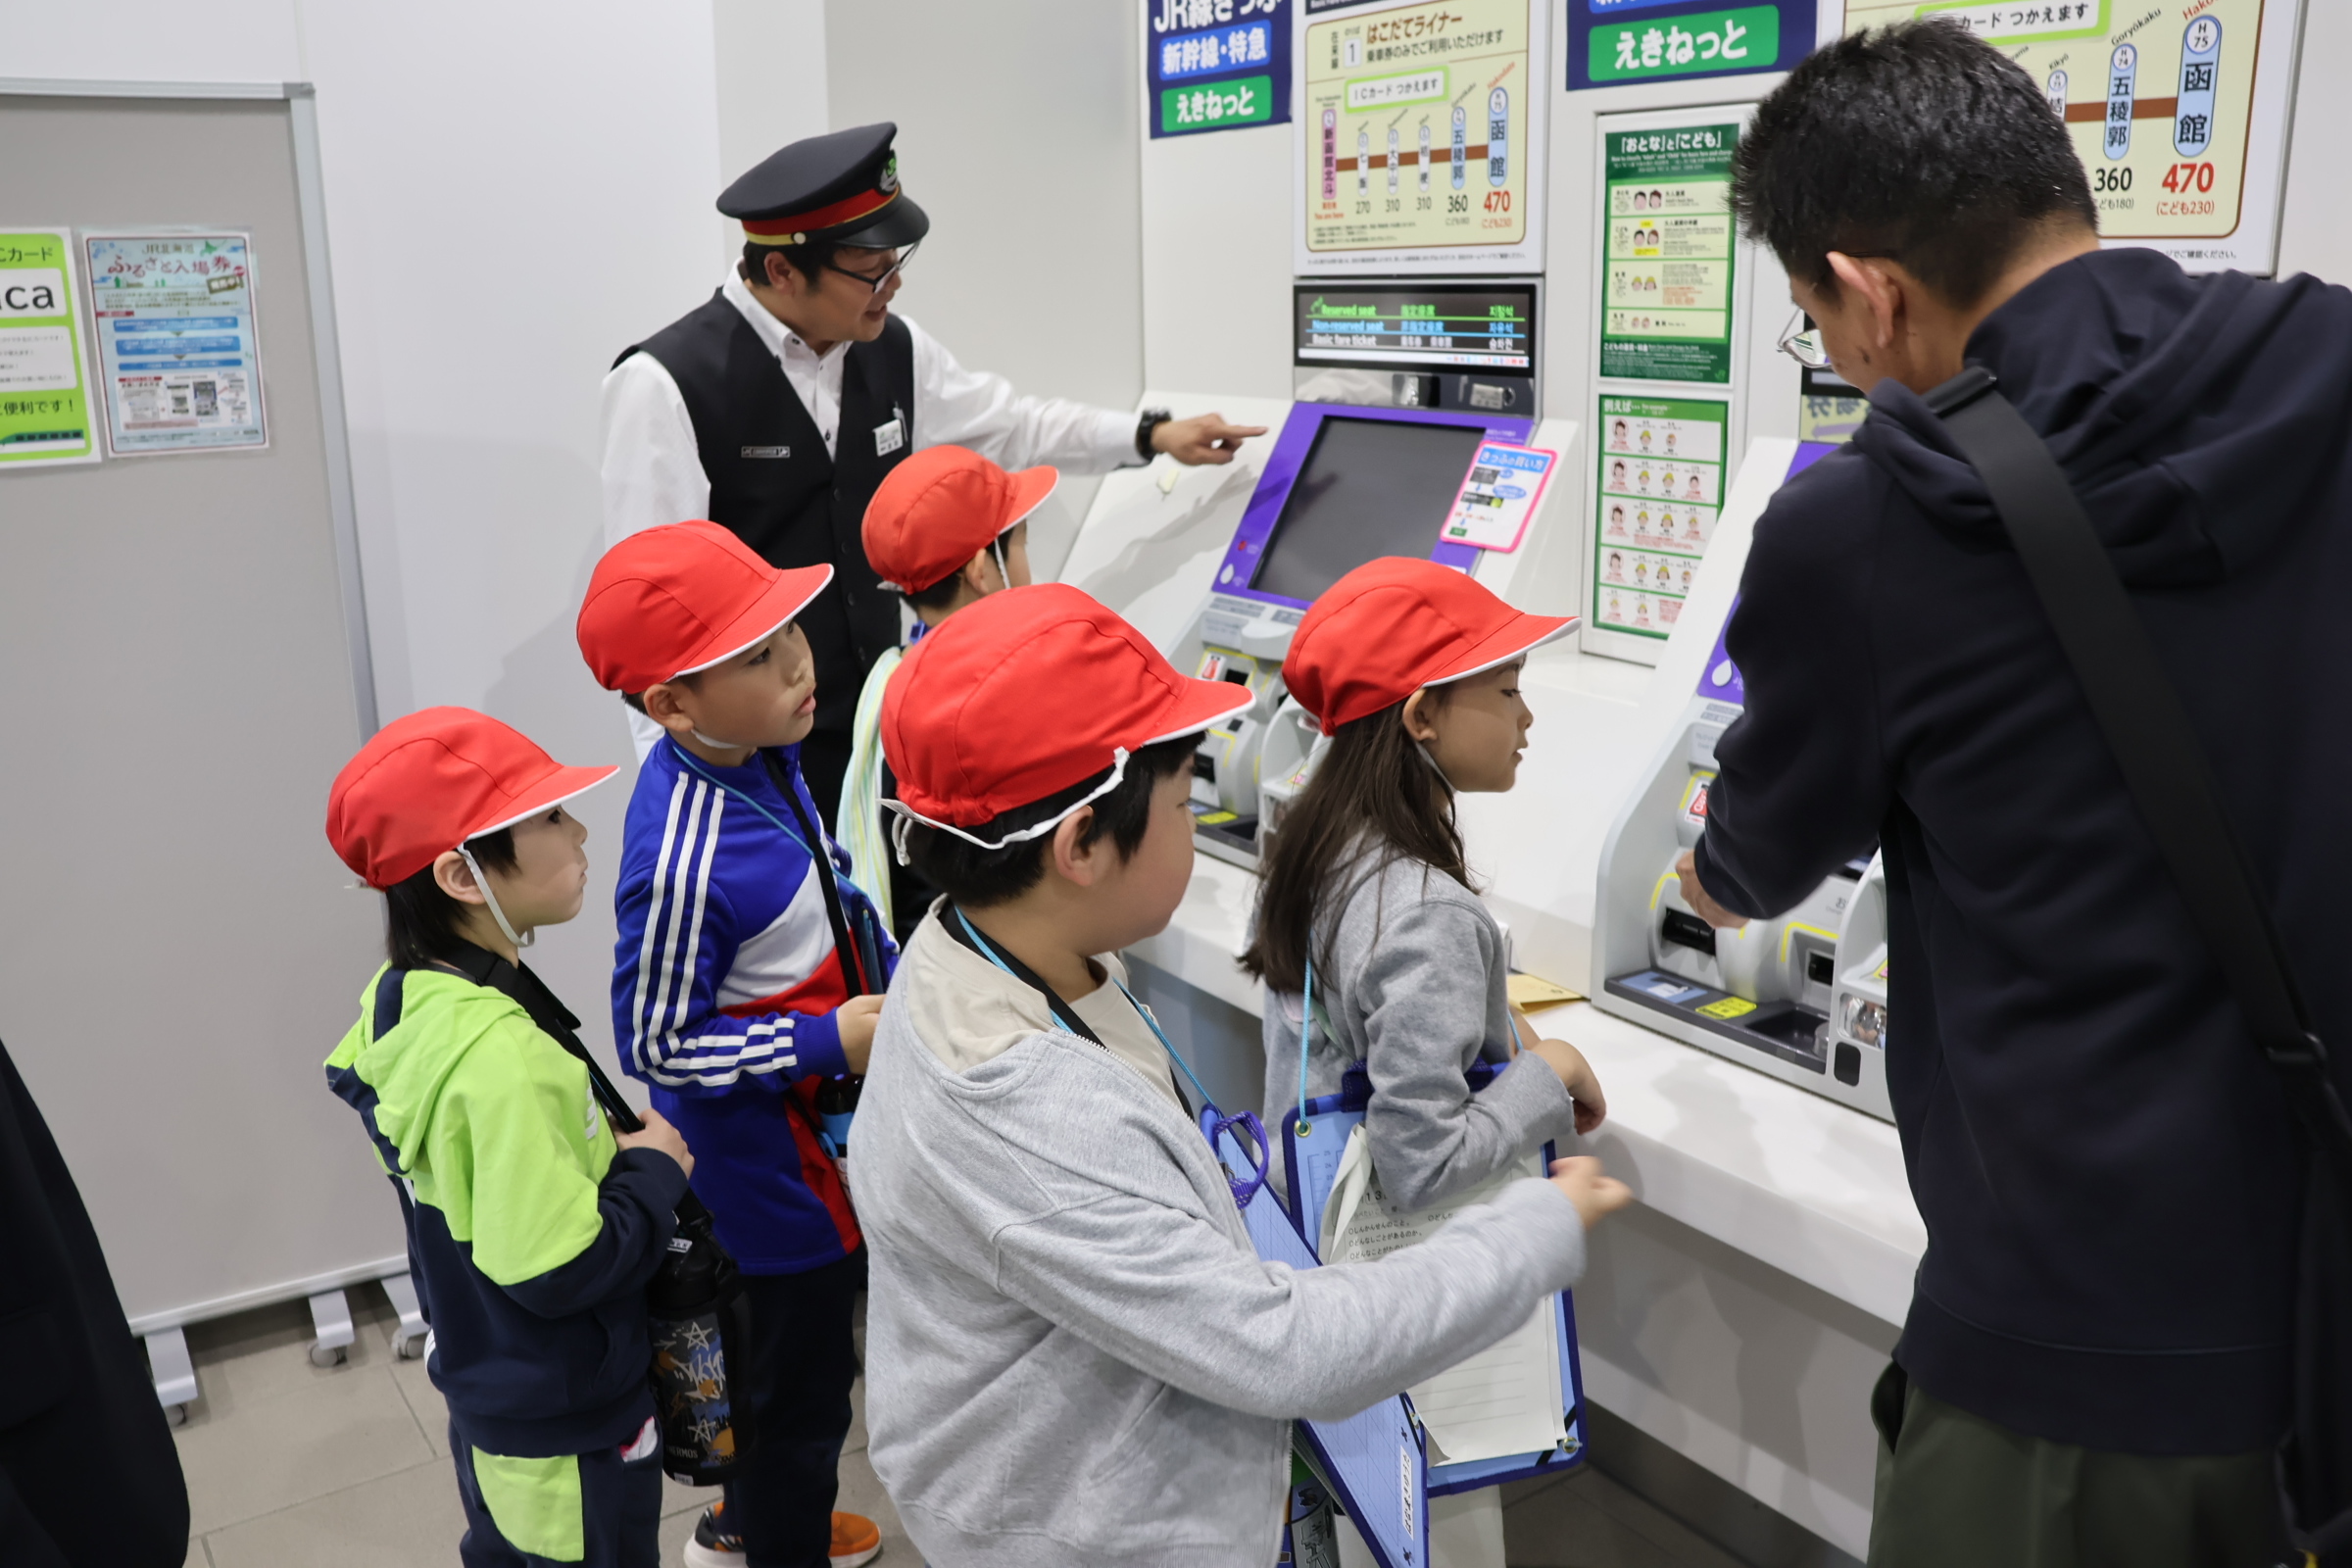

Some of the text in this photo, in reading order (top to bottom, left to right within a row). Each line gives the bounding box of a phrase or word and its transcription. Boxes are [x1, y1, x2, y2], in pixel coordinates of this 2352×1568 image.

[2010, 3, 2088, 26] つかえます
[2181, 0, 2219, 21] Hako
[1367, 11, 1463, 44] はこだてライナー
[2198, 23, 2207, 33] H
[1162, 27, 1267, 74] 新幹線・特急
[1366, 29, 1504, 63] 乗車券のみでご利用いただけます
[1615, 20, 1747, 70] えきねっと
[2193, 36, 2208, 48] 75
[1349, 43, 1355, 63] 1
[2118, 58, 2129, 67] 74
[1396, 77, 1439, 94] つかえます
[1177, 85, 1254, 122] えきねっと
[2107, 76, 2131, 148] 五稜郭
[2178, 61, 2215, 145] 函館
[1490, 119, 1505, 178] 函館
[1621, 130, 1722, 154] 「おとな」と「こども」
[1452, 129, 1464, 180] 五稜郭
[2094, 167, 2132, 192] 360
[2162, 162, 2215, 193] 470
[1355, 201, 1371, 215] 270
[1386, 199, 1400, 213] 310
[1416, 196, 1432, 211] 310
[1447, 194, 1468, 213] 360
[1484, 190, 1511, 213] 470
[2156, 201, 2215, 216] (こども230)
[108, 255, 231, 277] ふるさと入場券
[0, 285, 55, 311] ca
[1321, 304, 1376, 316] Reserved seat
[1312, 319, 1385, 331] Non-reserved seat
[1312, 333, 1376, 346] Basic fare ticket
[0, 400, 74, 416] 便利です！
[665, 1445, 698, 1459] THERMOS
